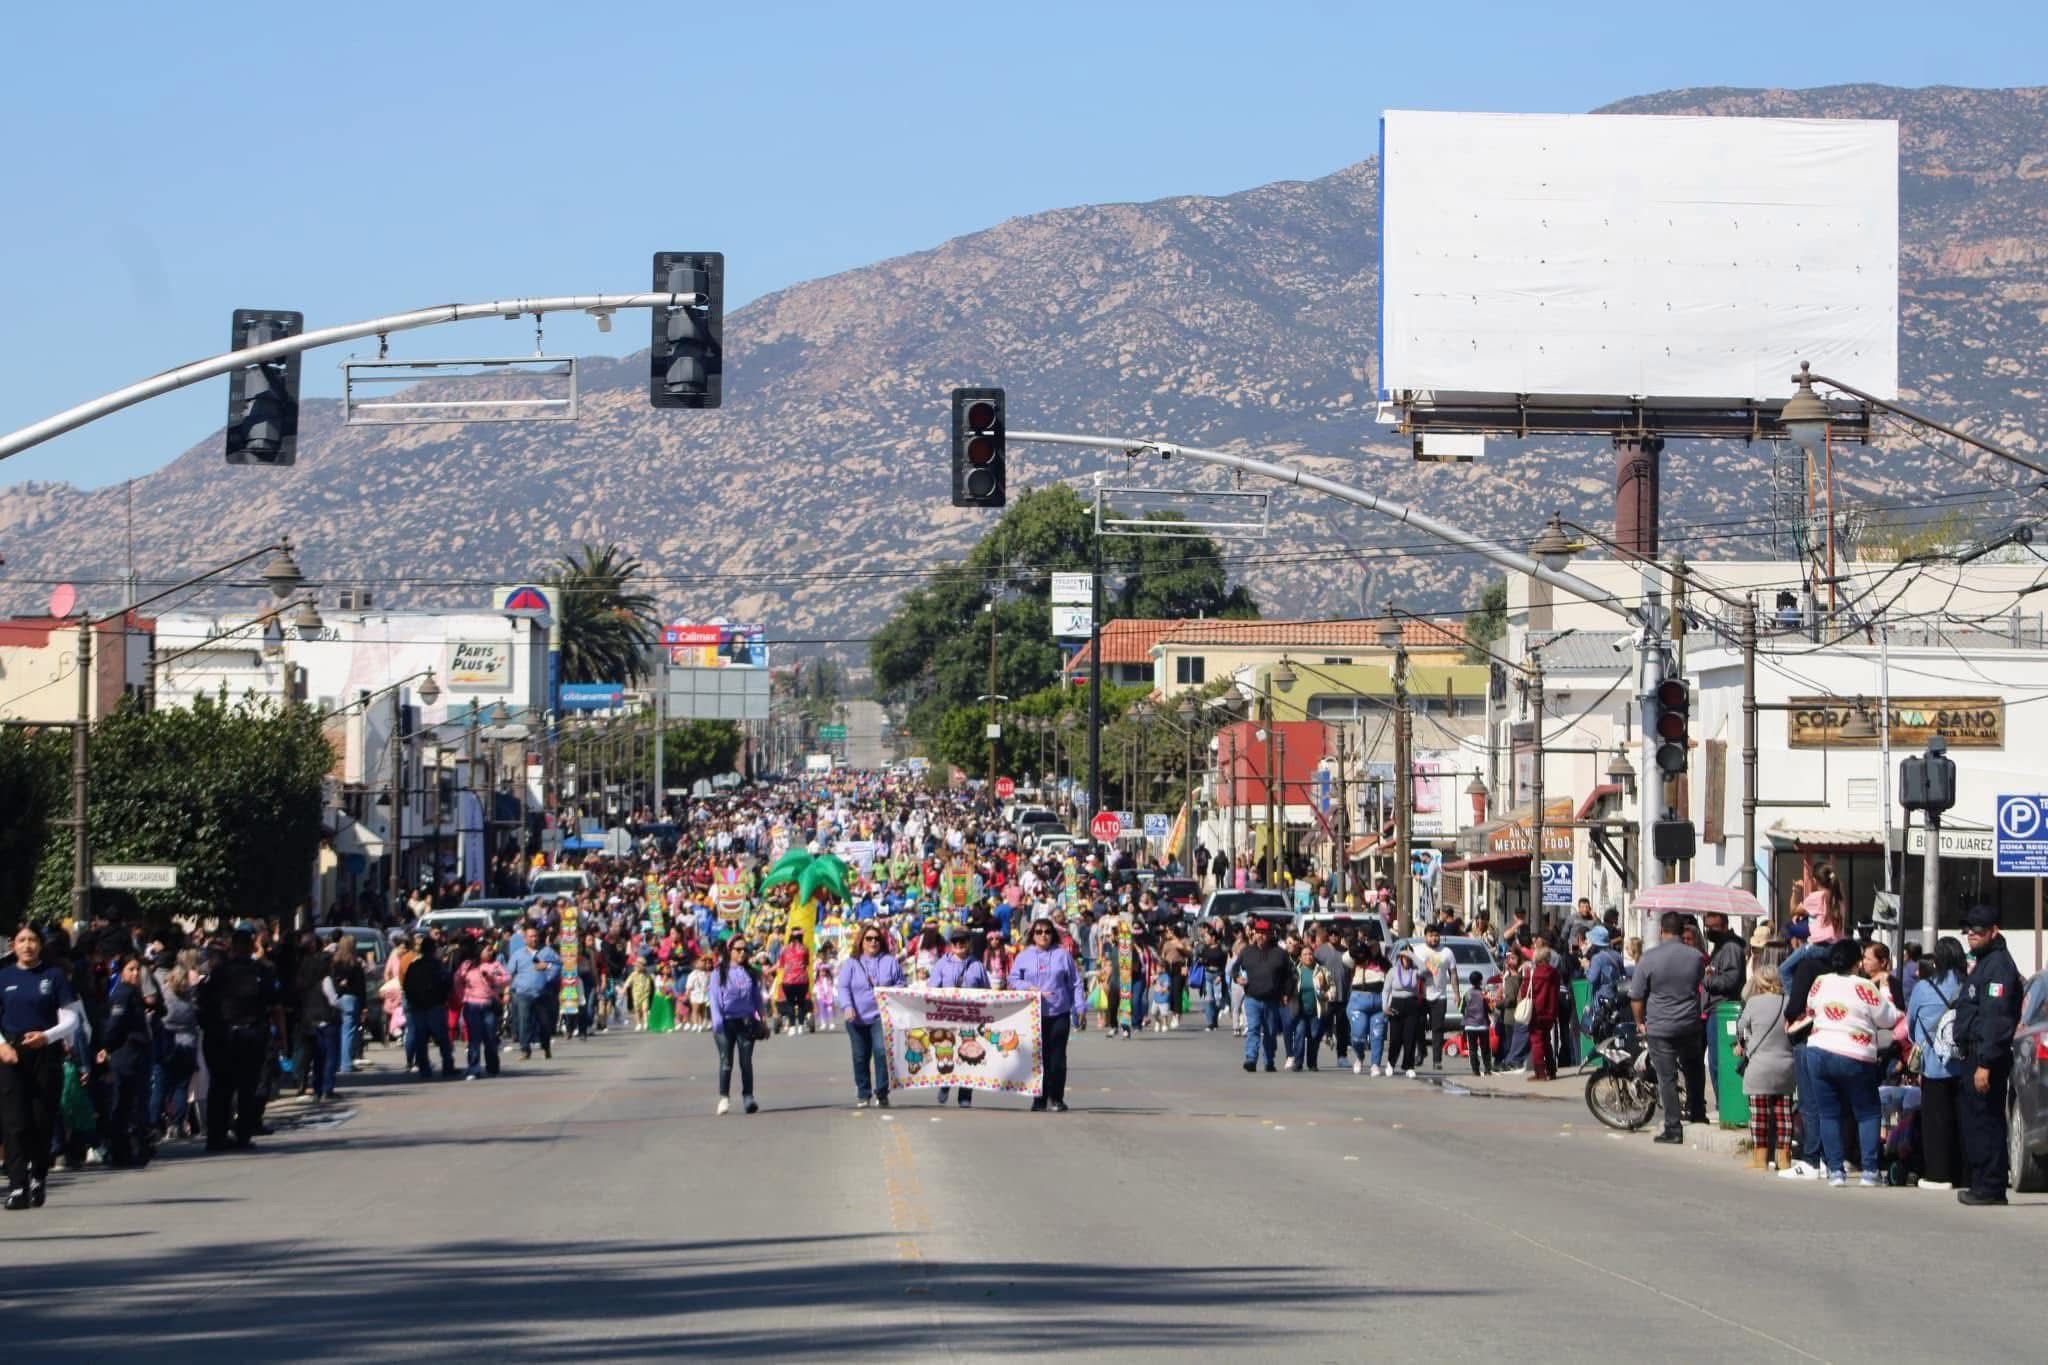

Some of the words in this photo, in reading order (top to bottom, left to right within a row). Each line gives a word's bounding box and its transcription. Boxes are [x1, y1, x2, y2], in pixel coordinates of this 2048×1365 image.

[456, 643, 494, 656] PARTS
[451, 658, 483, 670] PLUS
[1795, 711, 1900, 728] CORAON
[1936, 710, 1996, 728] SANO
[1094, 820, 1120, 833] ALTO
[1495, 838, 1535, 852] MEXICA
[1545, 836, 1571, 849] FOOD
[1955, 837, 1993, 851] JUAREZ
